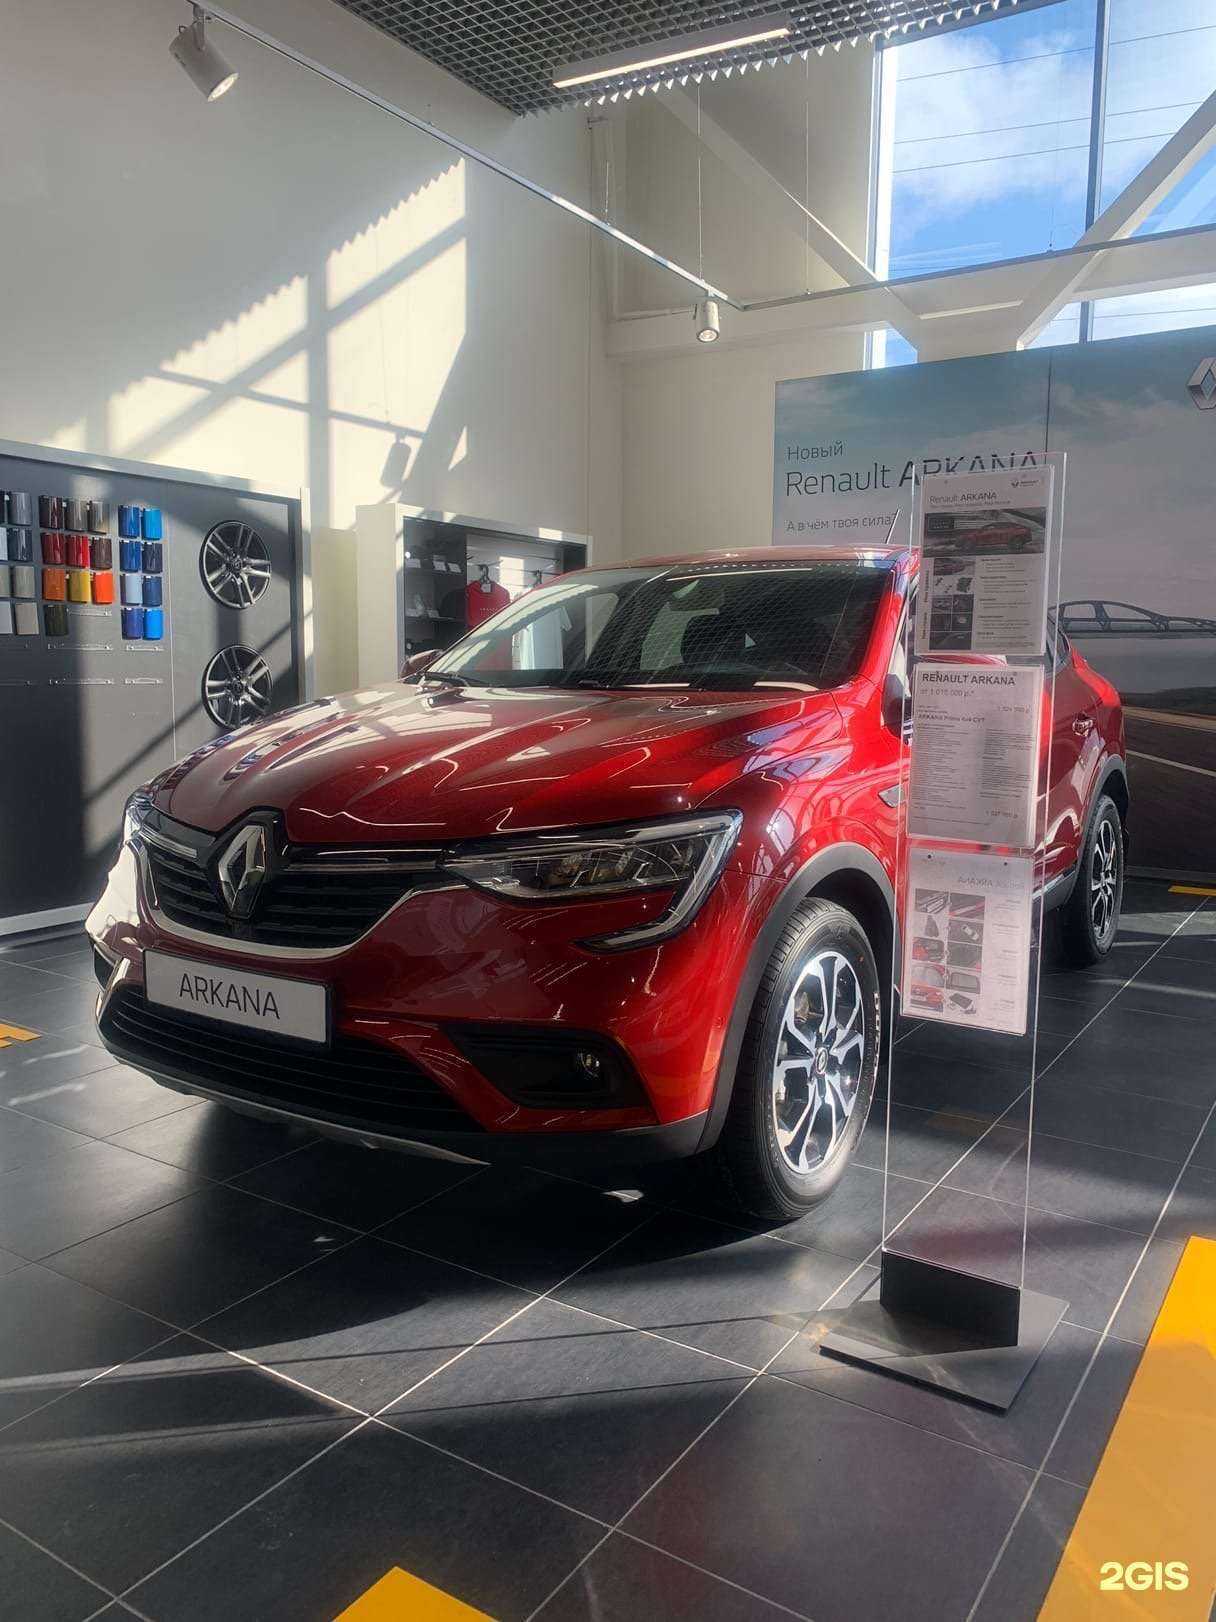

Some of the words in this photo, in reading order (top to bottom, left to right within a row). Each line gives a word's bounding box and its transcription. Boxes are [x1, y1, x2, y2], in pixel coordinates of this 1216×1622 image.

[787, 440, 843, 460] Новый
[786, 462, 891, 496] Renault
[929, 495, 960, 503] Renault
[960, 492, 998, 501] ARKANA
[786, 521, 795, 531] А
[832, 518, 859, 528] твоя
[922, 672, 969, 683] RENAULT
[971, 675, 1016, 685] ARKANA
[179, 973, 280, 1019] ARKANA
